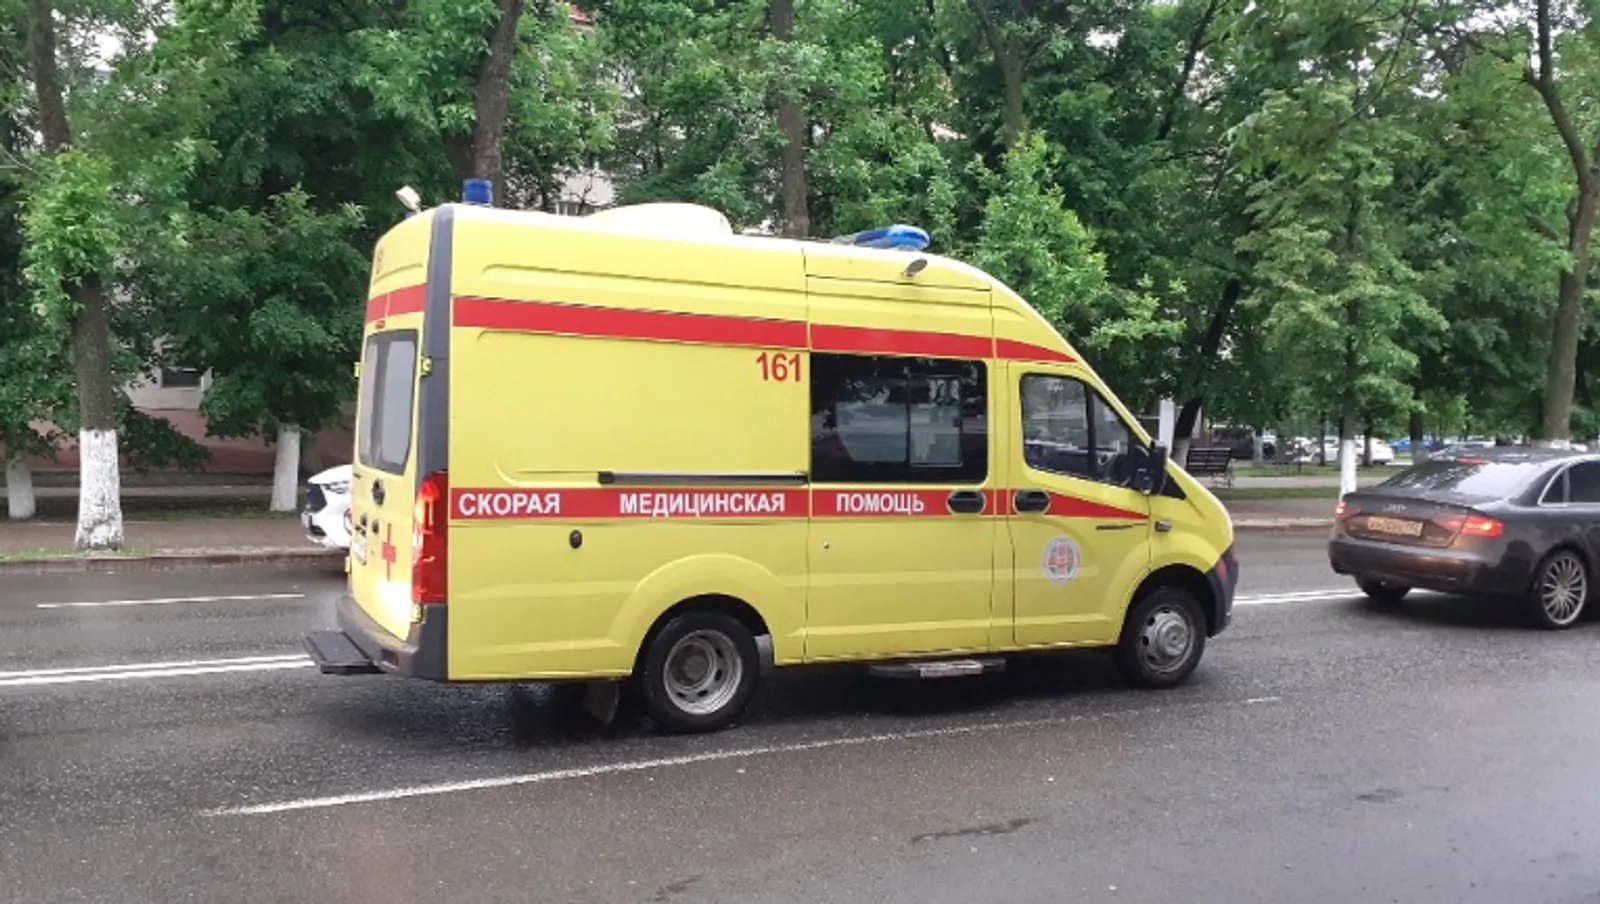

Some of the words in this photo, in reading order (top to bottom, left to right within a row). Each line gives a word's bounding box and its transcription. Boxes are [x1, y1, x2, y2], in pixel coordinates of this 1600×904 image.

[756, 351, 801, 382] 161
[458, 493, 561, 515] СКОРАЯ
[619, 493, 786, 517] МЕДИЦИНСКАЯ
[836, 493, 925, 515] ПОМОЩЬ
